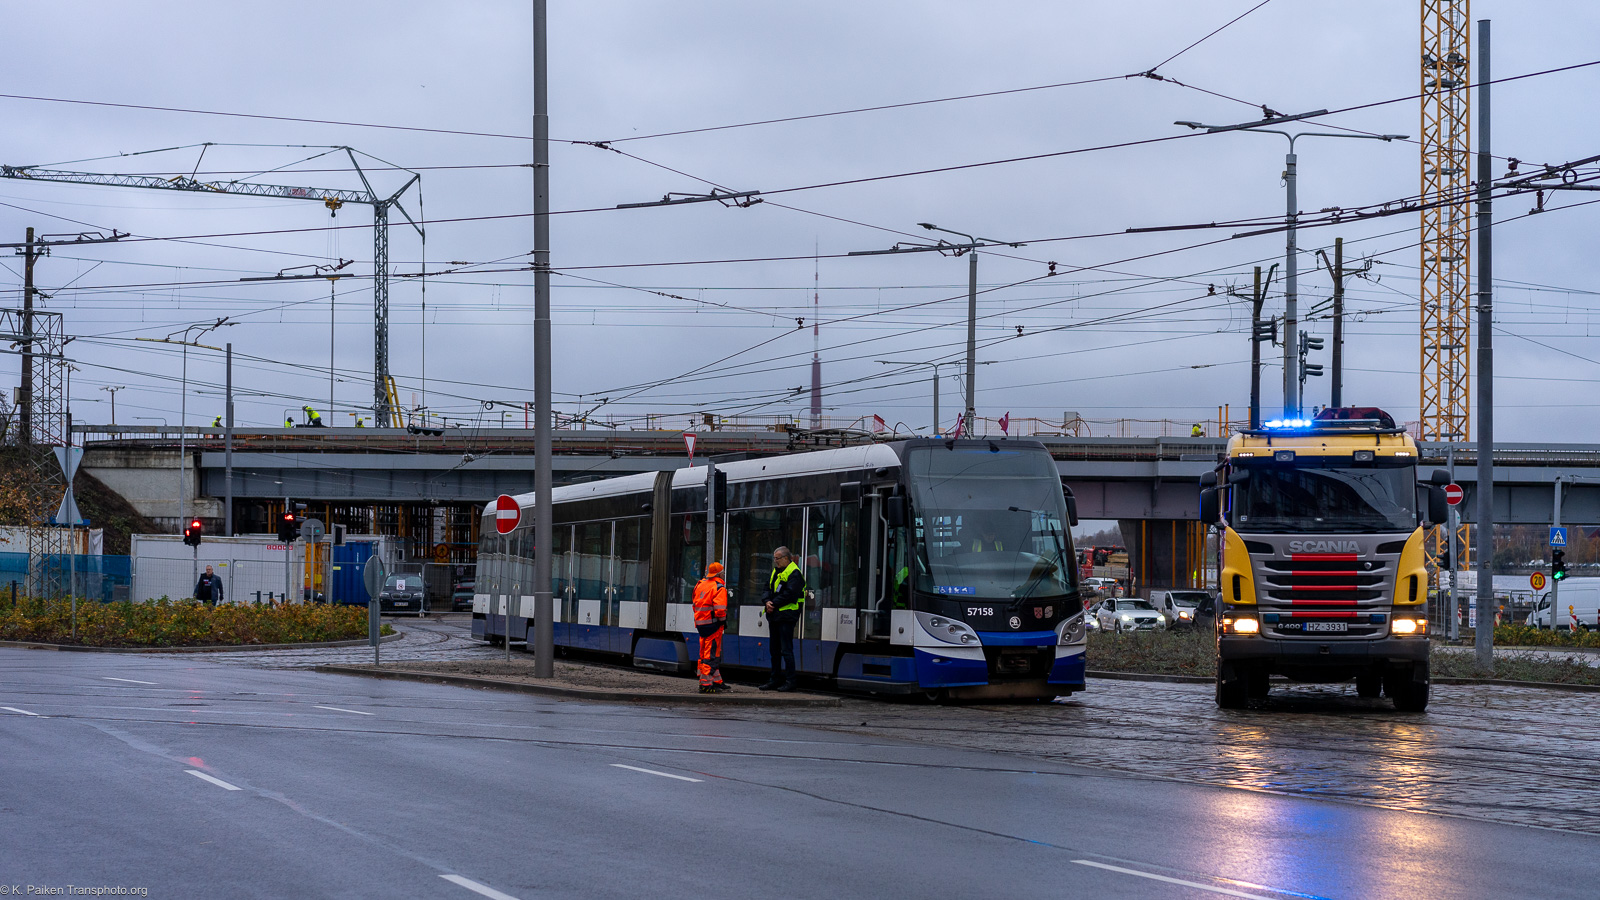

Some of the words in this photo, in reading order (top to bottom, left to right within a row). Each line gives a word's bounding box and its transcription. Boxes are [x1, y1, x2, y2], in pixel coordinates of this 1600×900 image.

[1289, 540, 1360, 552] SCANIA
[1534, 576, 1542, 585] 20
[967, 607, 994, 616] 57158
[1308, 623, 1346, 631] HZ-3931
